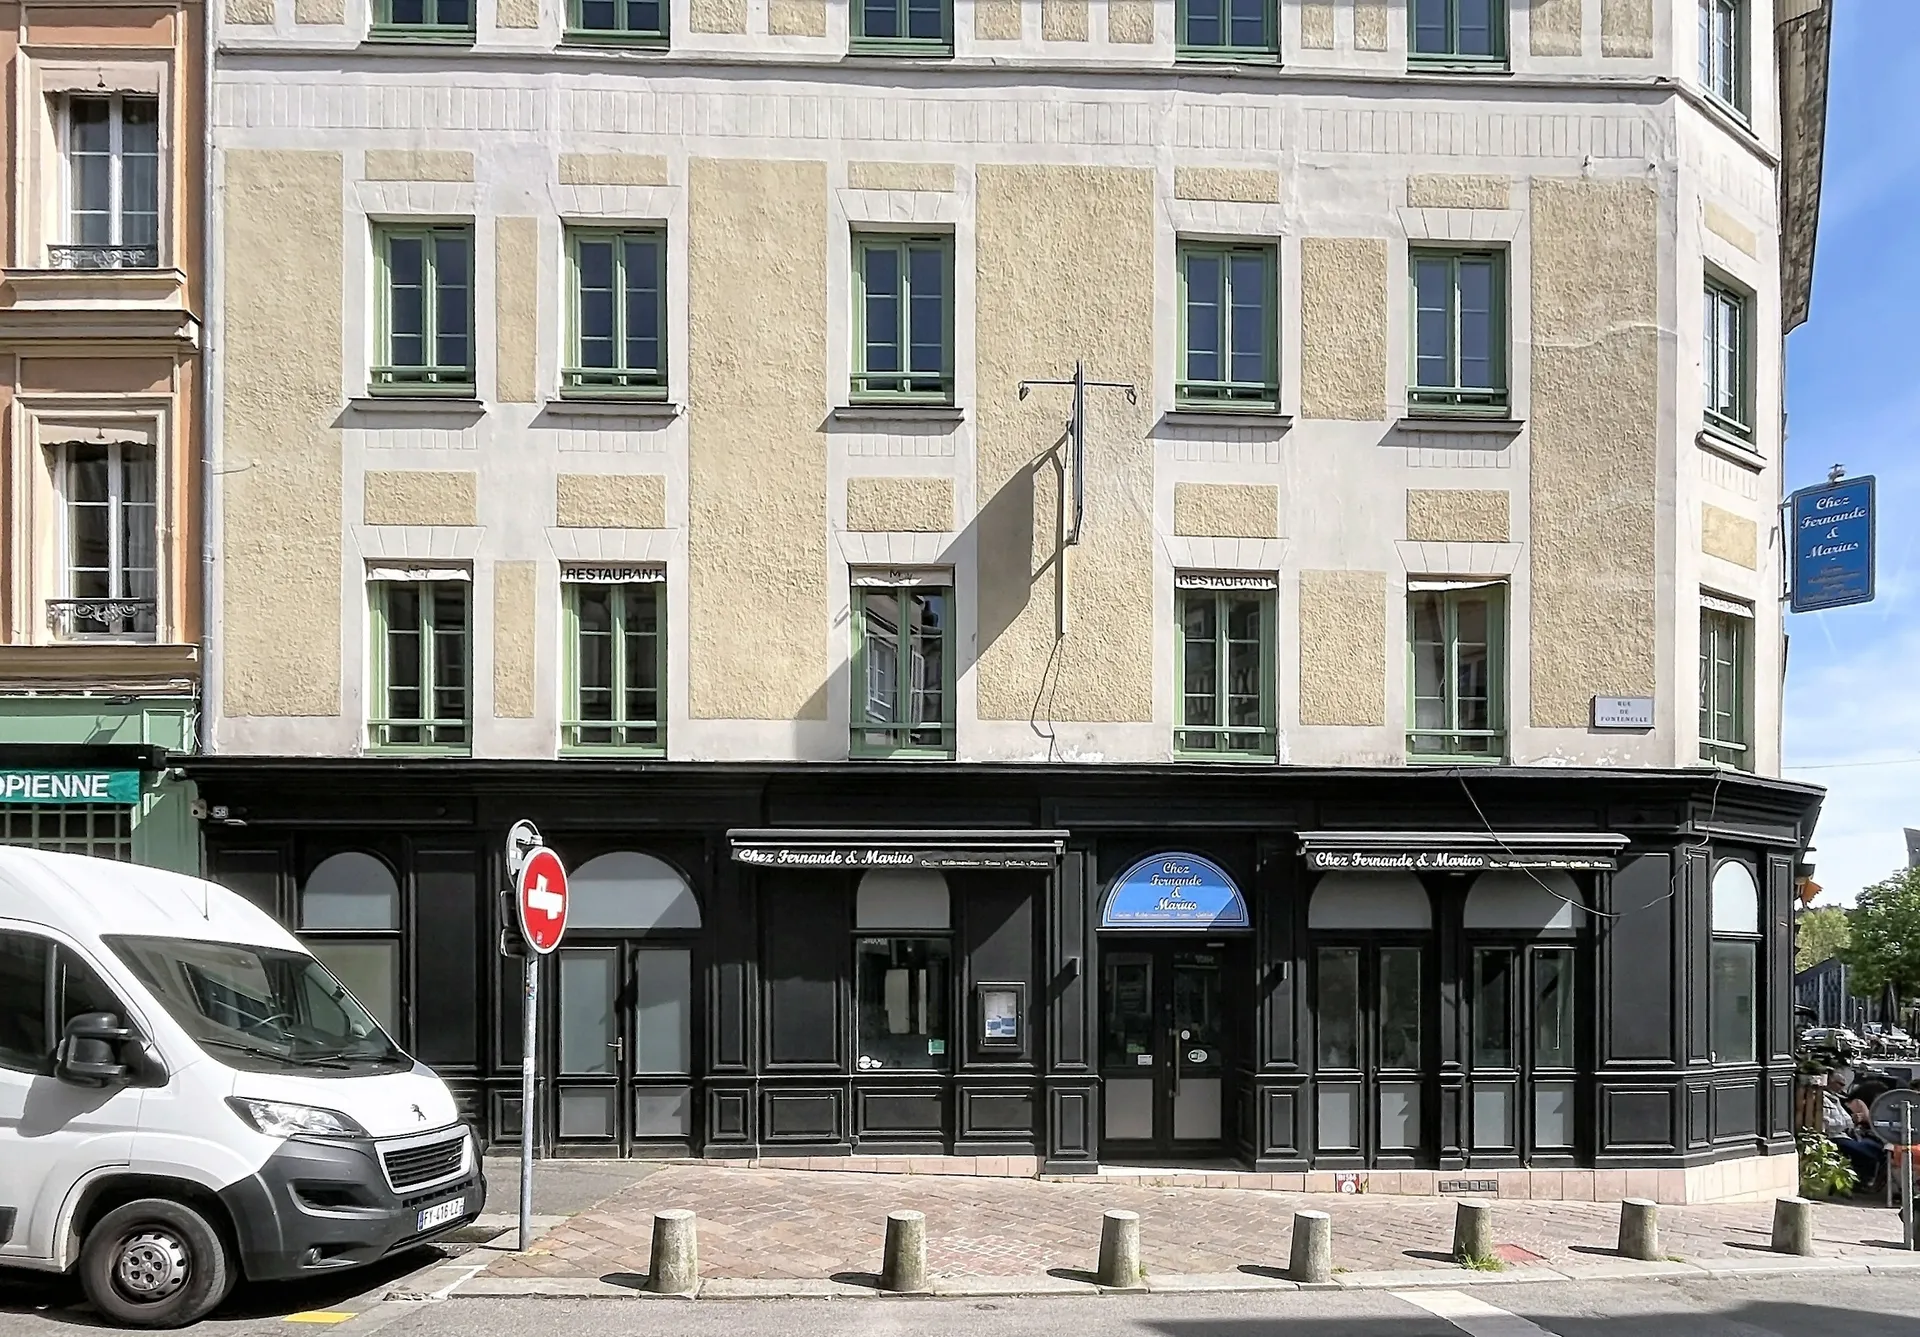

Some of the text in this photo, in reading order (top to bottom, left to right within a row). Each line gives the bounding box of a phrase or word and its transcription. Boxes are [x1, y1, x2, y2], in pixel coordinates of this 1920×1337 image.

[1816, 496, 1850, 510] Chez
[1800, 506, 1867, 529] Fernande
[1826, 526, 1839, 539] &
[1805, 541, 1859, 559] Marius
[566, 568, 662, 580] RESTAURANT
[1179, 574, 1271, 587] RESTAURANT
[0, 774, 110, 798] PIENNE
[738, 849, 775, 863] Chez
[777, 849, 842, 864] Fernande
[845, 850, 858, 864] &
[860, 850, 914, 864] Marius
[1315, 852, 1349, 866] Chez
[1351, 852, 1413, 867] Fernande
[1416, 852, 1429, 867] &
[1431, 852, 1484, 867] Marius
[1162, 862, 1190, 874] Chez
[1150, 874, 1202, 886] Fernande
[1171, 886, 1181, 898] &
[1154, 899, 1197, 911] Marius
